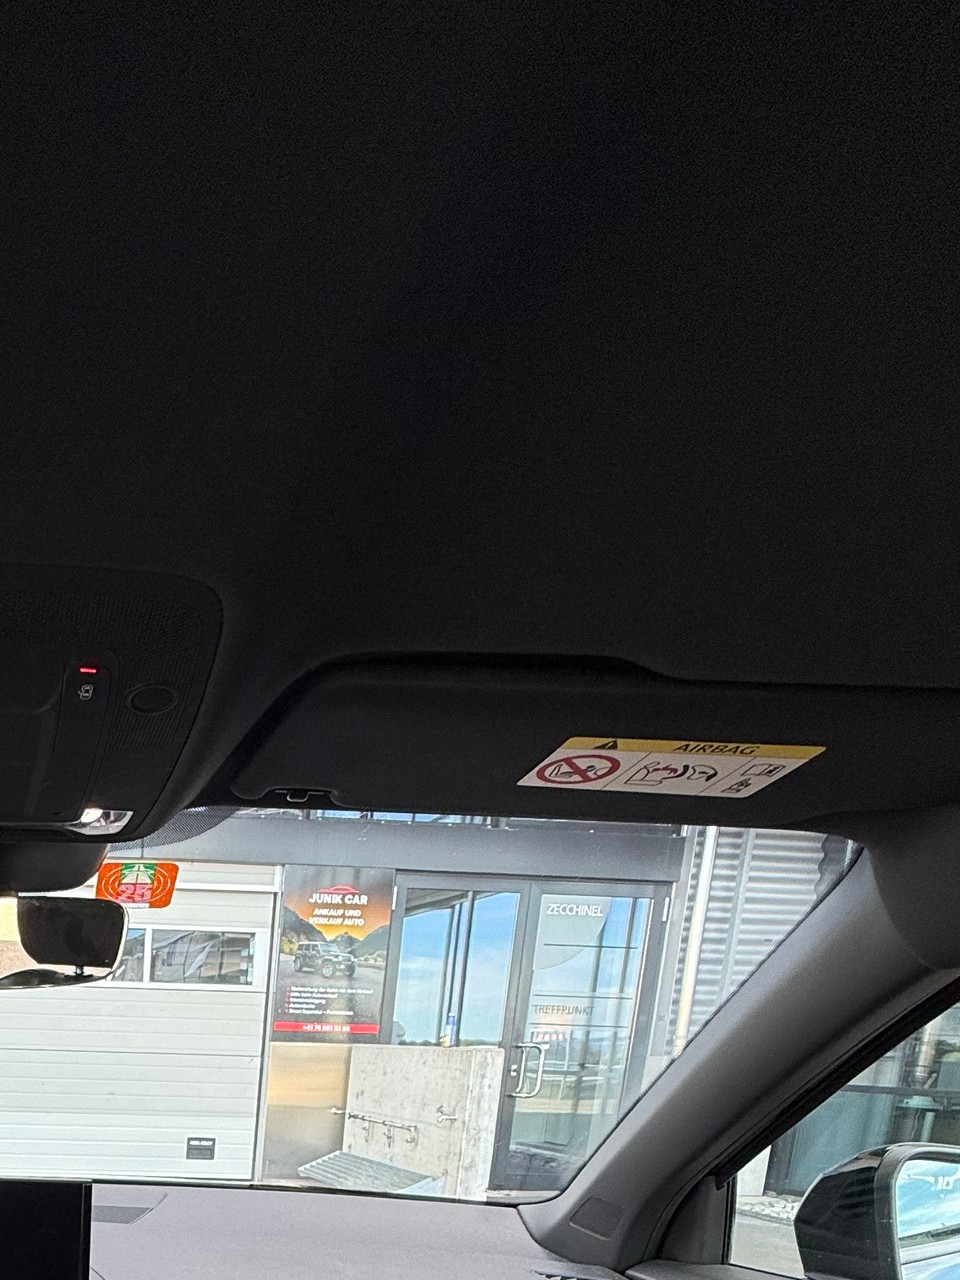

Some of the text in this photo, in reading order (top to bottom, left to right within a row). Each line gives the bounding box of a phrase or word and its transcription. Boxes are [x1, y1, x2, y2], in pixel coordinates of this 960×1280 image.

[672, 743, 760, 755] AIRBAG
[309, 893, 368, 905] JUNIK CAR
[313, 908, 362, 917] ANKAUF UND
[344, 918, 365, 926] AUTO
